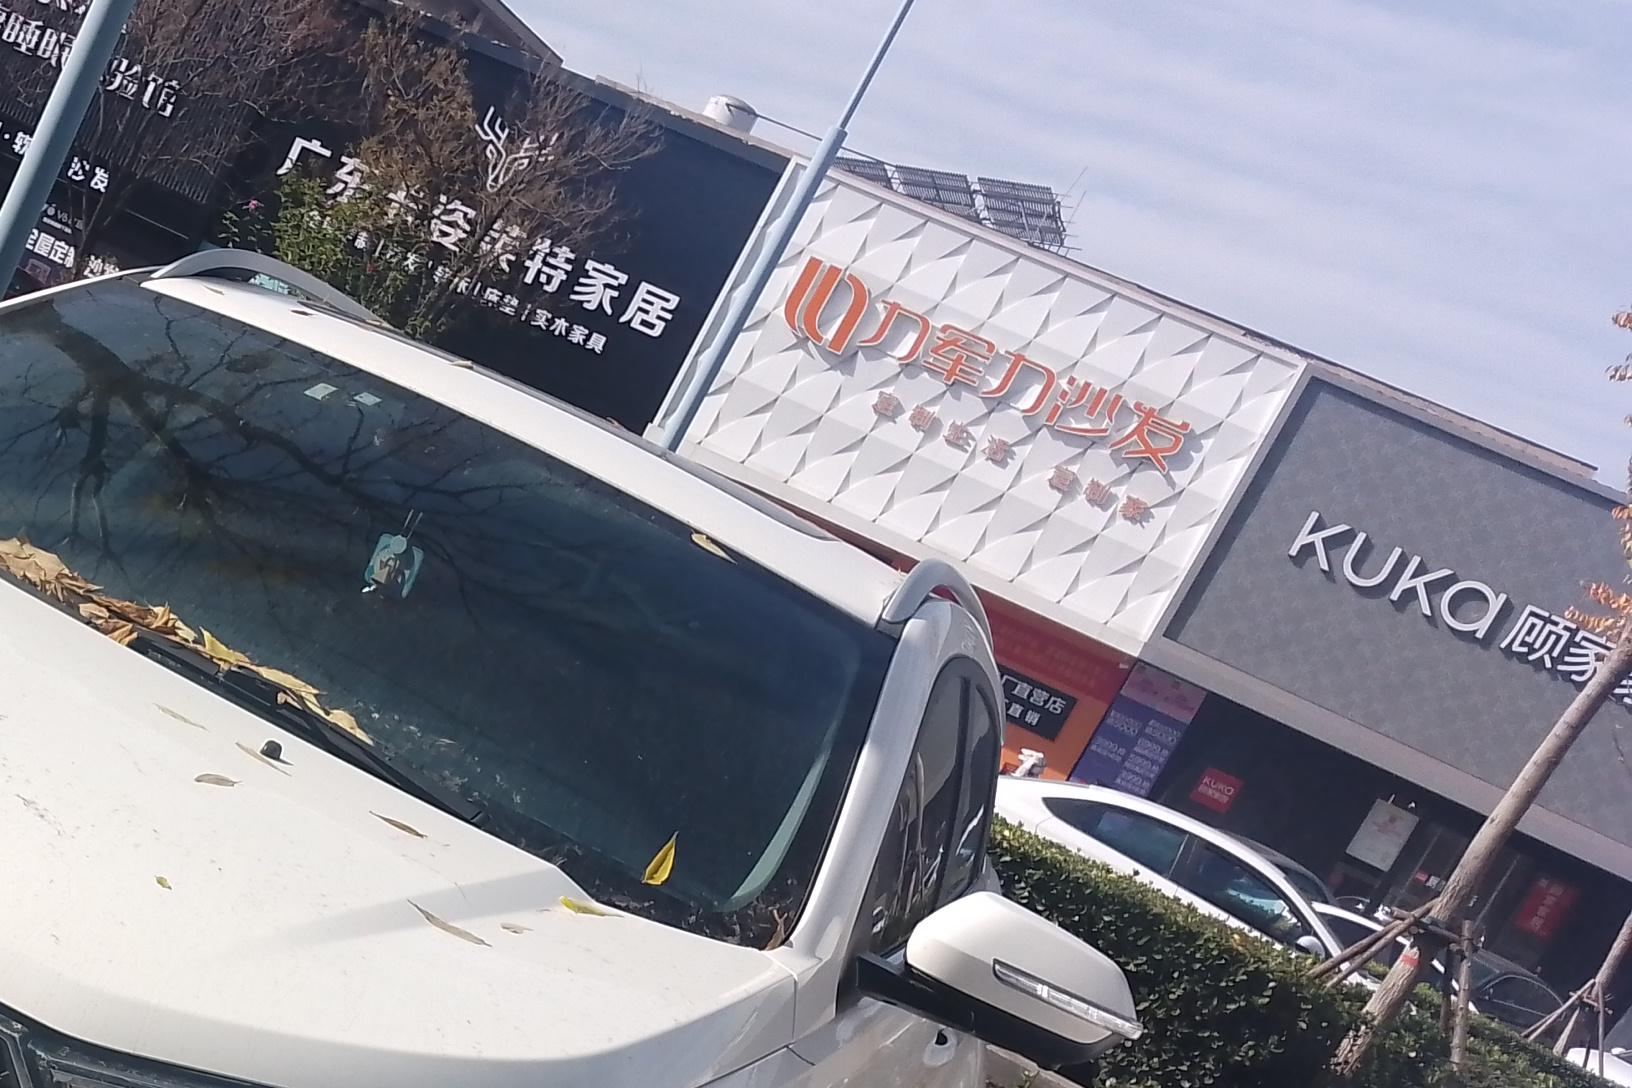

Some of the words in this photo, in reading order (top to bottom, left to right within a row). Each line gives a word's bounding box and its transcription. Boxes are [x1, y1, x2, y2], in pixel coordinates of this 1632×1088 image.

[530, 308, 607, 354] 实木家具
[857, 299, 1191, 474] 力军力沙发
[1499, 604, 1632, 705] 顾家
[1004, 698, 1041, 726] 直销
